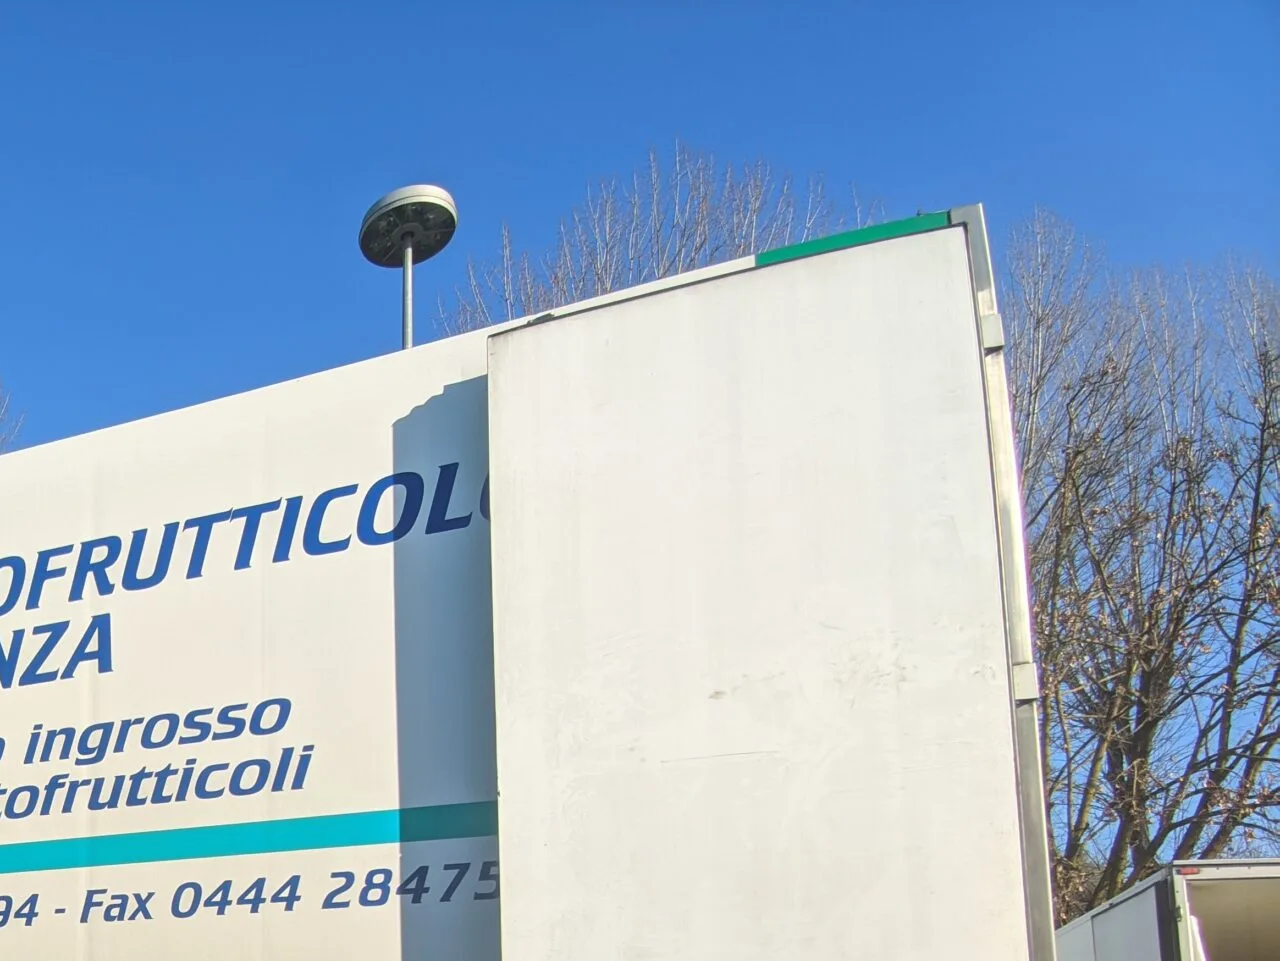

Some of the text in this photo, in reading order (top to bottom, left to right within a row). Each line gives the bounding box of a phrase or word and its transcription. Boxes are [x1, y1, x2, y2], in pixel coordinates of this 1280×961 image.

[22, 697, 293, 769] ingrosso
[80, 888, 155, 924] Fax
[170, 874, 302, 919] 0444
[321, 861, 500, 910] 28475
